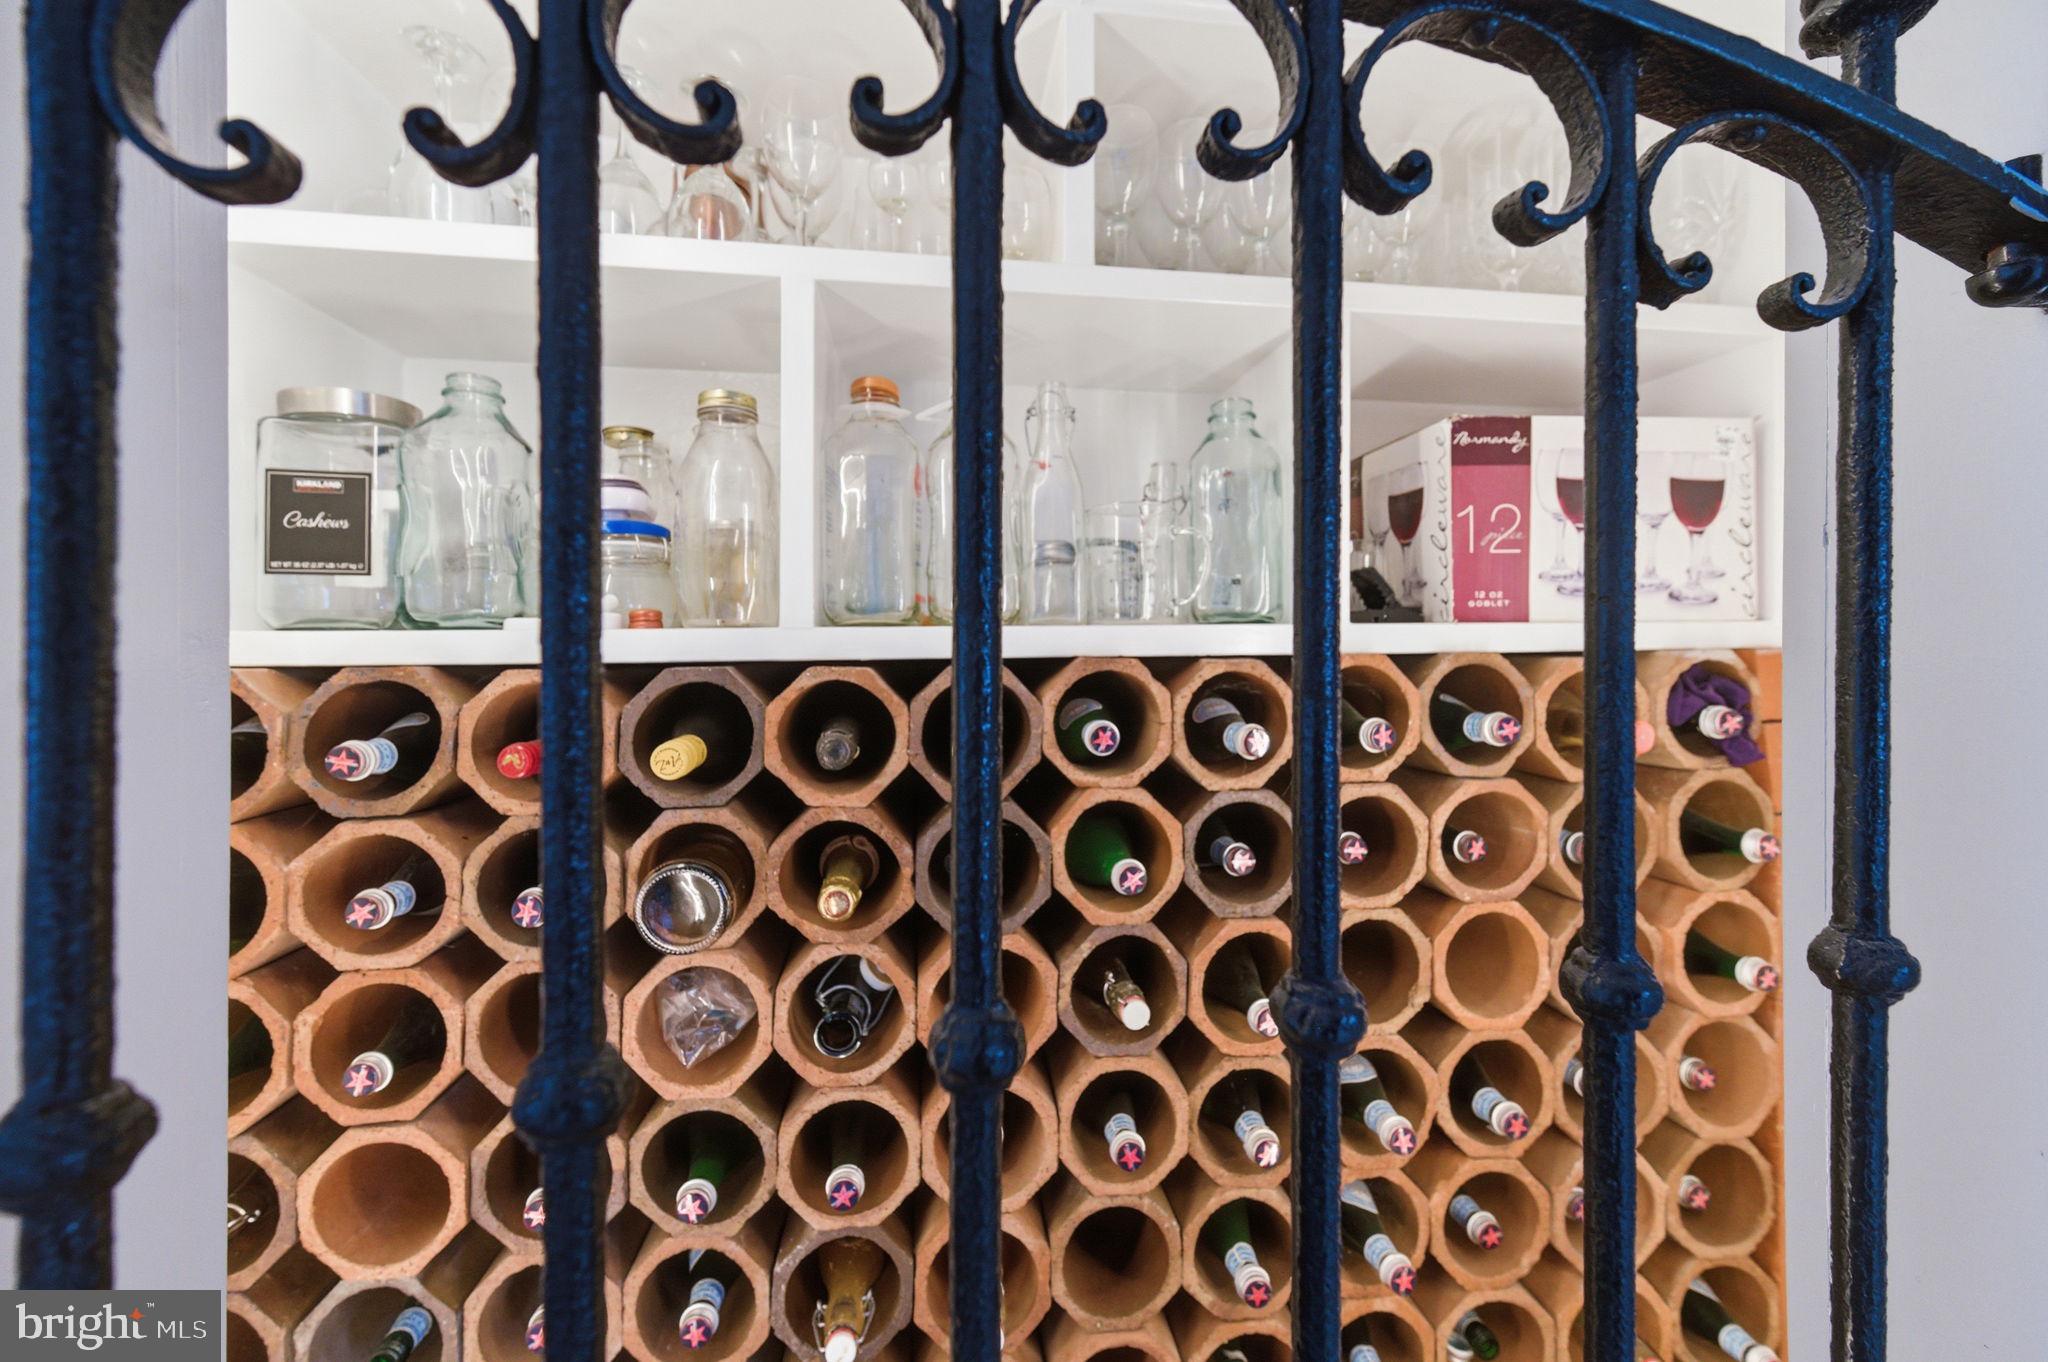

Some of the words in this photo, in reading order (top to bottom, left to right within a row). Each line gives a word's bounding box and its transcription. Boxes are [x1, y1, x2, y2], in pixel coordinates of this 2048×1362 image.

[1453, 430, 1529, 453] Normandy
[283, 510, 350, 529] Cashews
[1457, 503, 1522, 553] 12
[1467, 599, 1511, 608] GOBLET
